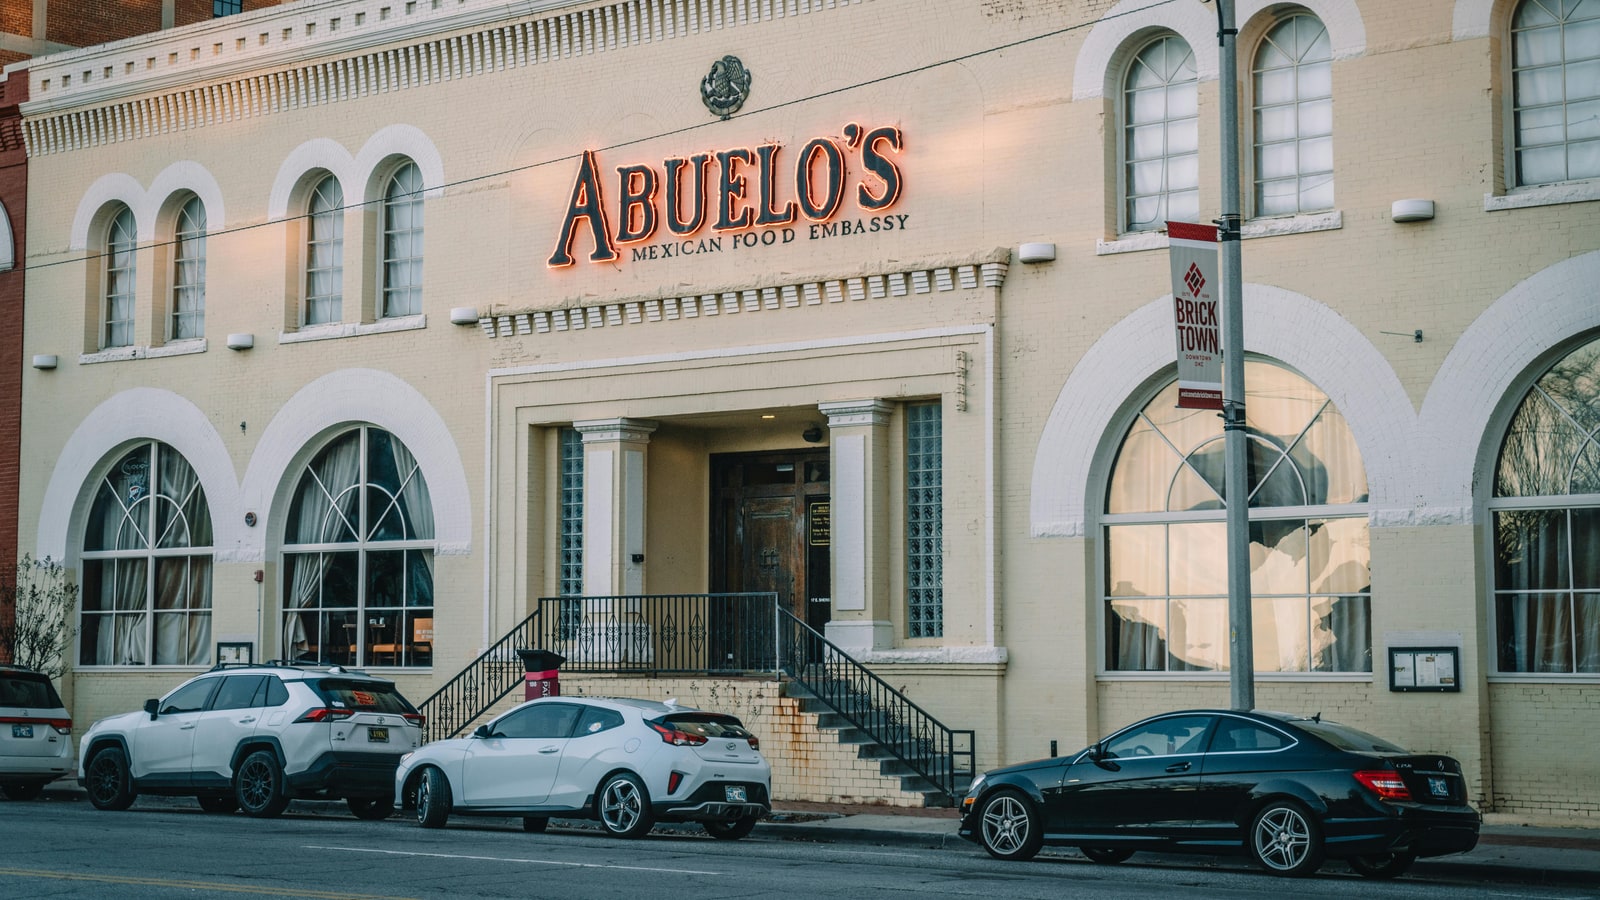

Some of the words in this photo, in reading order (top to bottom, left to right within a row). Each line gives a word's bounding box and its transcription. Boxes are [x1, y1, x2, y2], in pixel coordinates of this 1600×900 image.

[547, 122, 904, 269] ABUELO'S
[632, 237, 723, 262] MEXICAN
[733, 228, 796, 250] FOOD
[810, 214, 910, 241] EMBASSY
[1176, 297, 1217, 326] BRICK
[1178, 326, 1218, 355] TOWN
